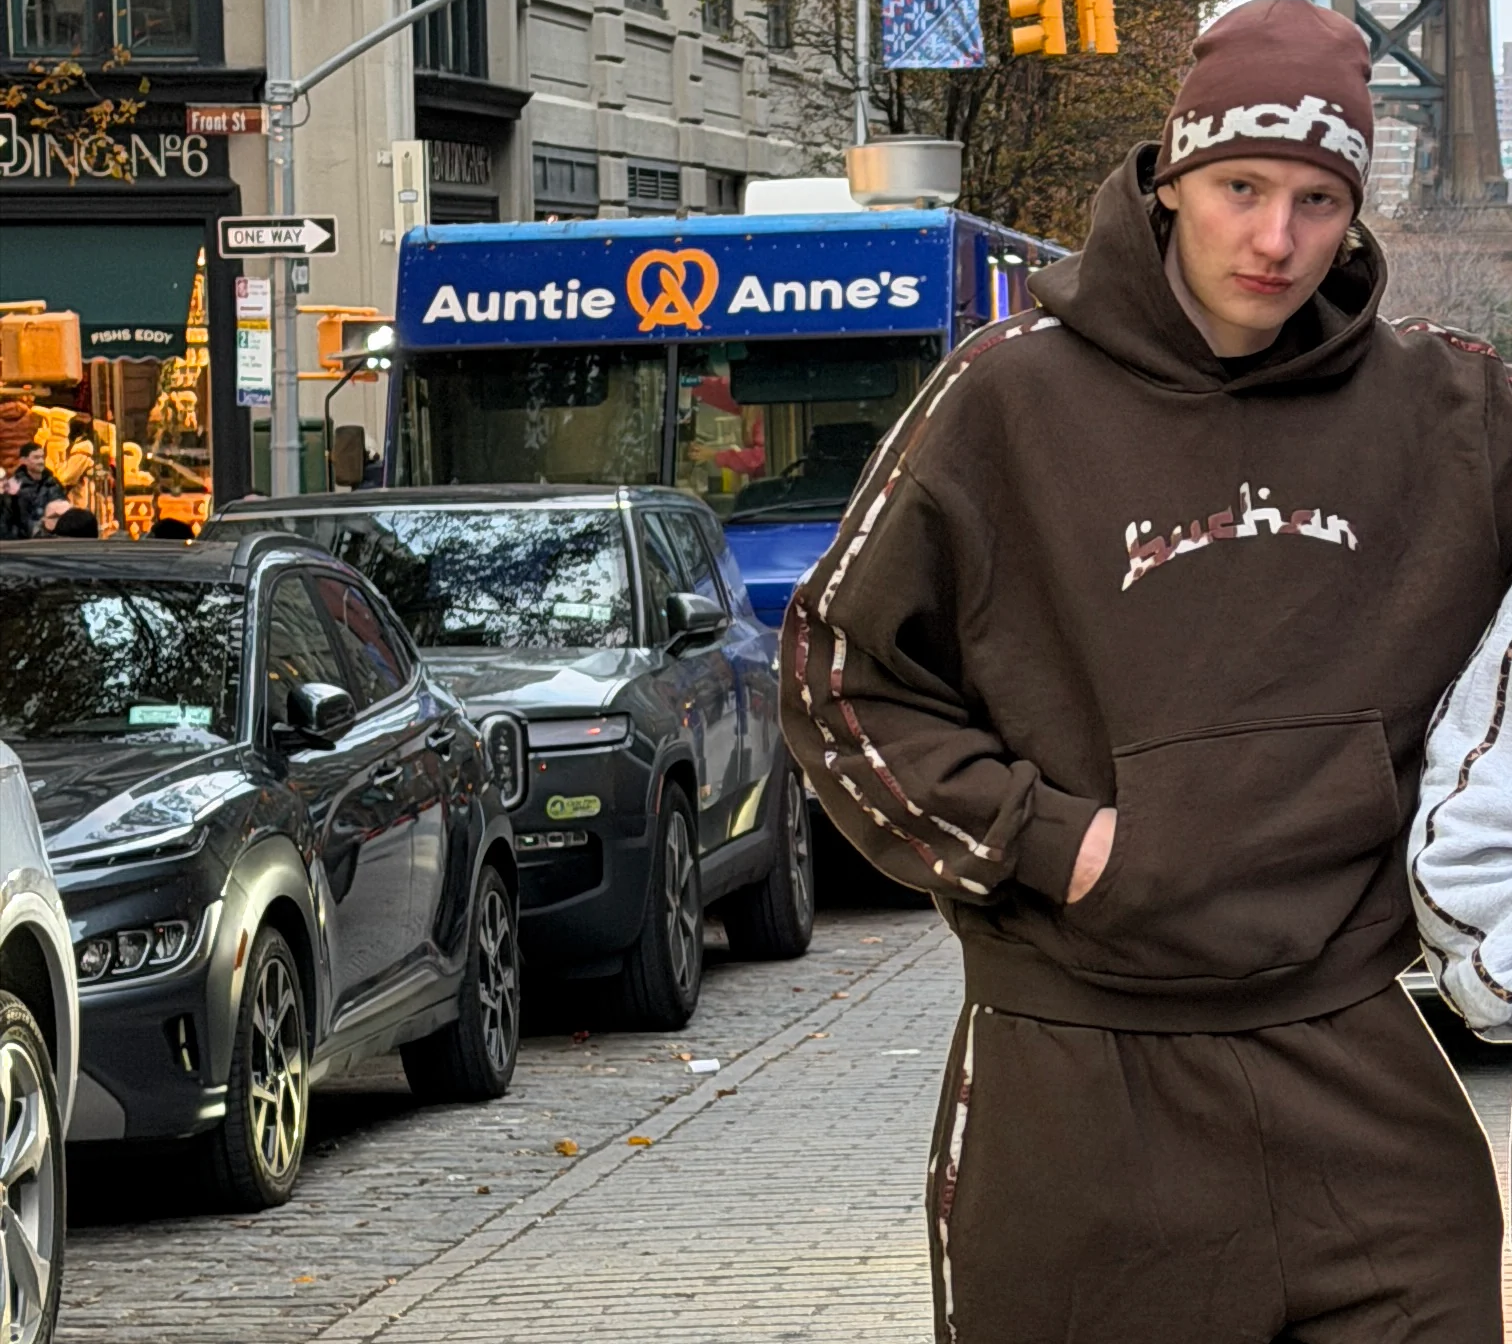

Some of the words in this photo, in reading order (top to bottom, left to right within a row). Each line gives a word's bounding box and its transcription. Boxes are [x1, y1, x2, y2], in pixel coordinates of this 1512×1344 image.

[191, 111, 228, 132] Front
[231, 109, 246, 132] St
[234, 229, 265, 244] ONE
[271, 229, 302, 244] WAY
[422, 278, 616, 324] Auntie
[727, 271, 921, 314] Anne's
[91, 328, 132, 345] FISHS
[134, 328, 174, 345] EDDY
